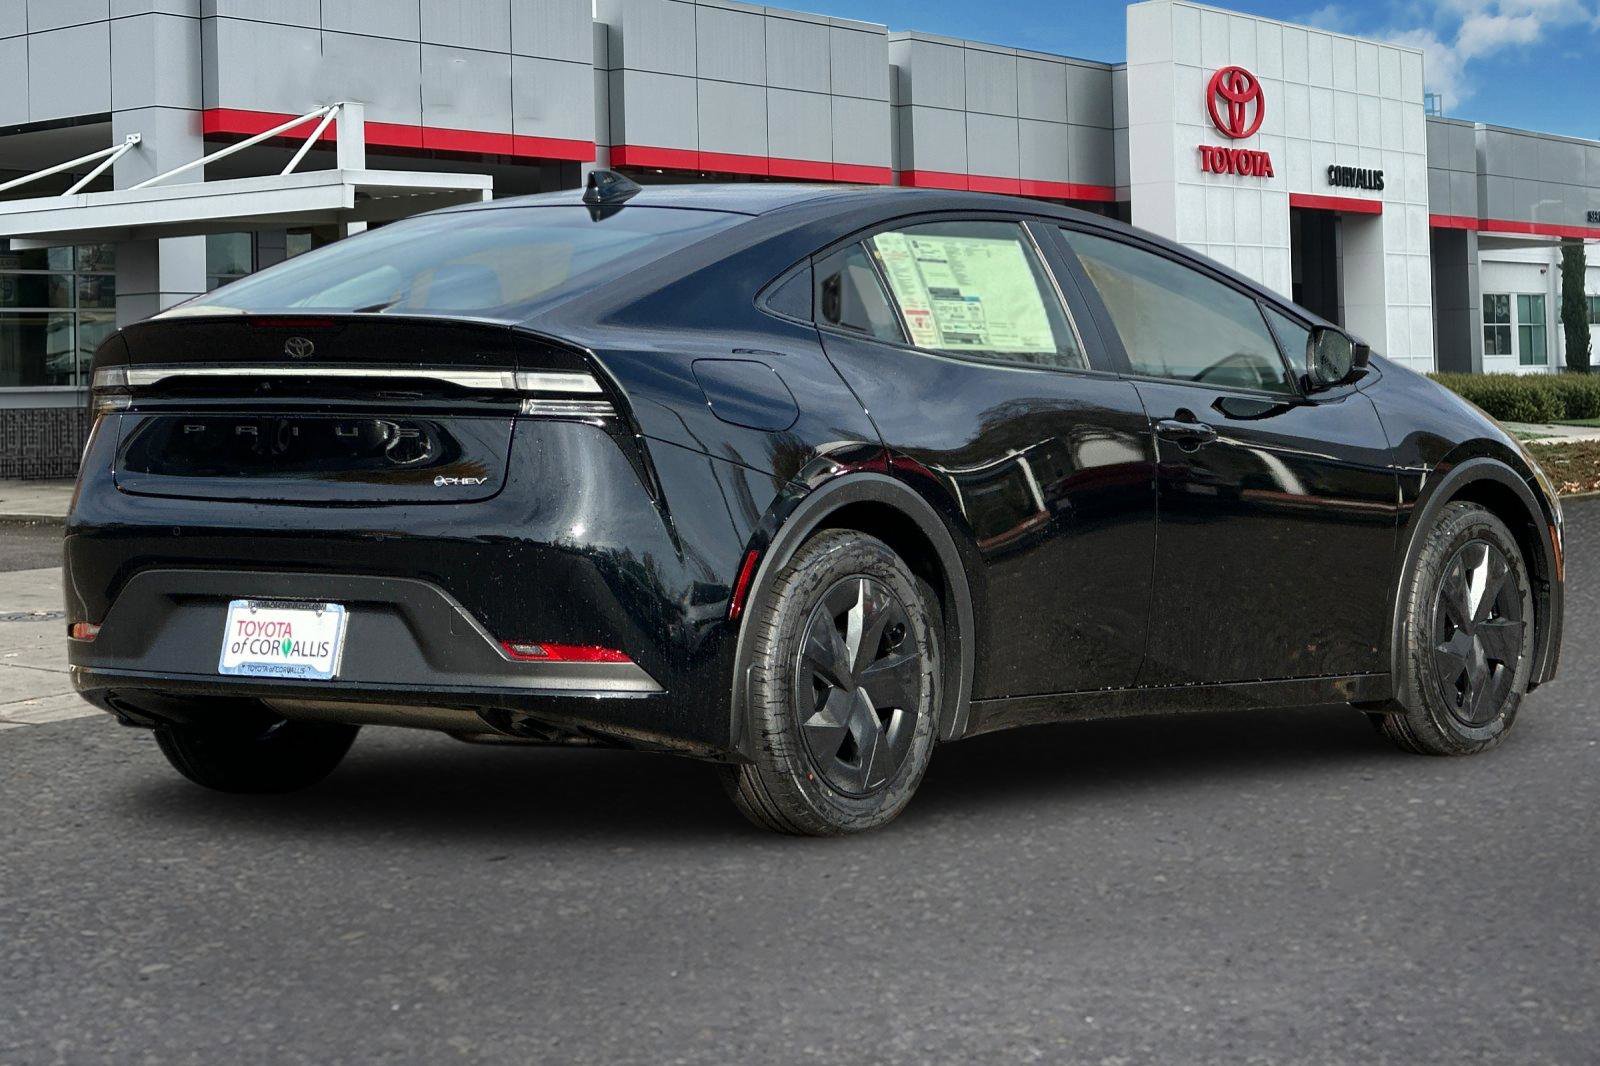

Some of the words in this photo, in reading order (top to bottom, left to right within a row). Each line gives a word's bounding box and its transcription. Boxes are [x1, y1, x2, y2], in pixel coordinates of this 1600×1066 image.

[1199, 145, 1275, 178] TOYOTA
[1327, 164, 1385, 191] CORVALLIS
[184, 423, 420, 438] PRIUS
[237, 620, 292, 638] TOYOTA
[231, 637, 250, 655] of
[247, 664, 268, 673] TOYOTA
